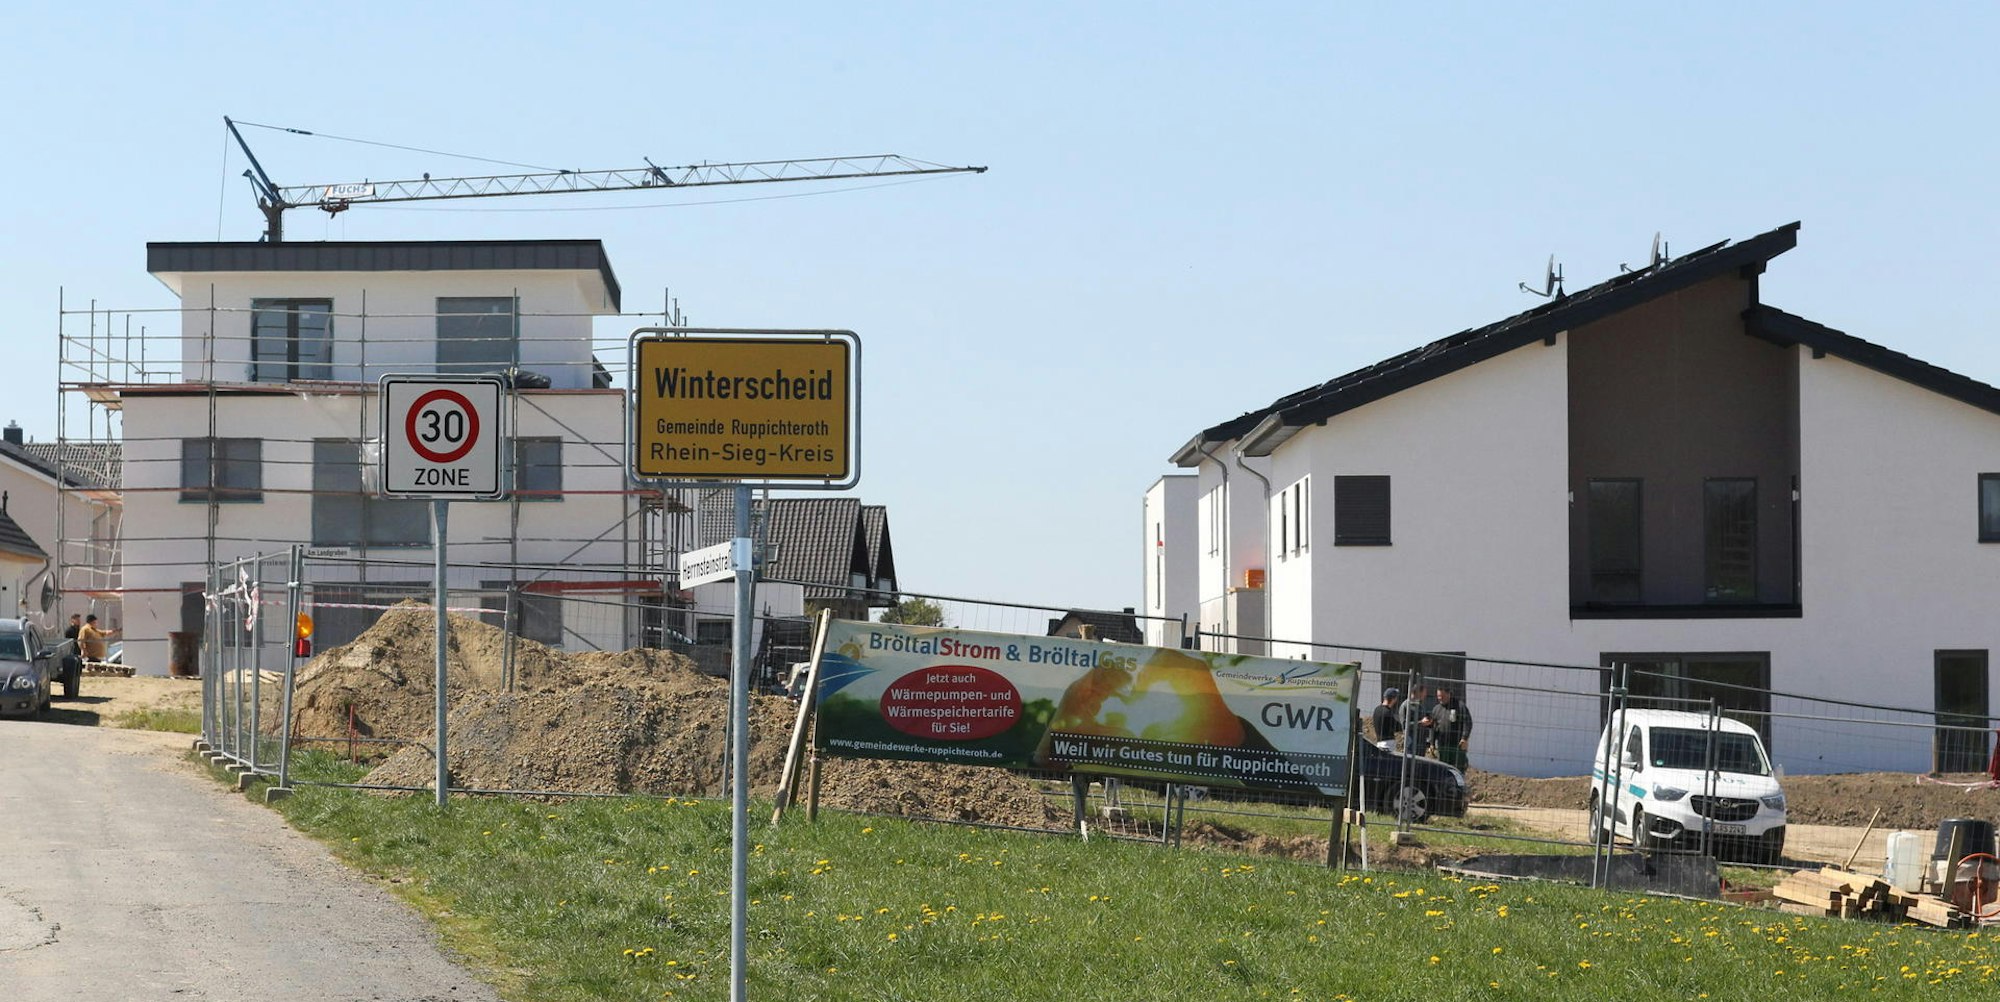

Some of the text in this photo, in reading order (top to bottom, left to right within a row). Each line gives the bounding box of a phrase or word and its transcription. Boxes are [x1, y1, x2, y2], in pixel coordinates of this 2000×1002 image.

[655, 367, 832, 400] Winterscheid
[421, 410, 463, 442] 30
[657, 419, 829, 439] Gemeinde Ruppichteroth
[651, 443, 834, 465] Rhein-Sieg-Kreis
[414, 468, 470, 486] ZONE
[682, 547, 732, 581] Herrnsteinstraß
[869, 631, 1137, 672] BröltalStrom & BröltalGas
[926, 673, 976, 684] Jetzt auch
[1216, 670, 1273, 681] Gemeindewerke
[891, 688, 1012, 702] Wärmepumpen- und
[887, 705, 1015, 719] Wärmespeichertarife
[1261, 702, 1334, 731] GWR
[931, 722, 970, 733] für Sie!
[829, 738, 1002, 759] www.gemeindewerke-ruppichteroth.de
[1054, 740, 1331, 777] Weil wir Gutes tun für Ruppichteroth
